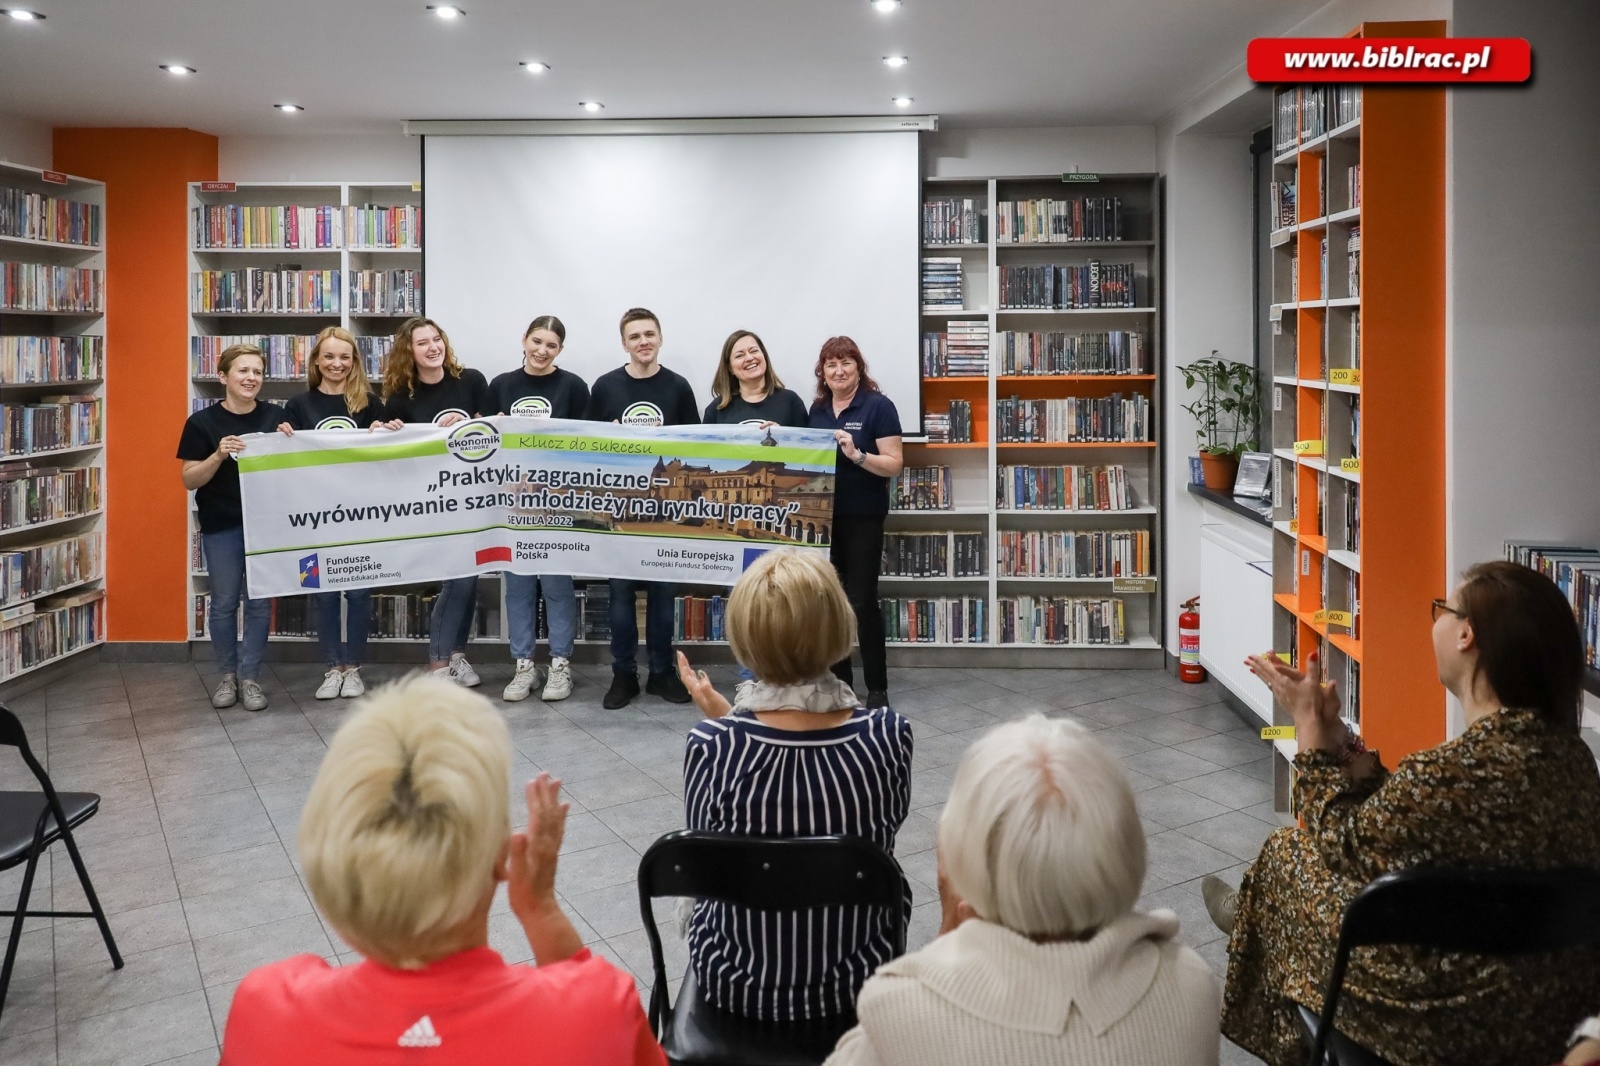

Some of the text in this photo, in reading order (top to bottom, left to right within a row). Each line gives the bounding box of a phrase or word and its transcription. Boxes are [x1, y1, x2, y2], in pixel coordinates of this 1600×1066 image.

[1090, 262, 1099, 292] LEGION
[1333, 372, 1348, 380] 200
[448, 435, 500, 448] ekonomik
[519, 436, 652, 454] Klucz do sukcesu
[1295, 442, 1310, 450] 500
[1343, 460, 1359, 468] 600
[427, 464, 520, 492] „Praktyki
[527, 468, 649, 488] zagraniczne
[288, 490, 799, 530] wyrównywanie szans młodzieży na rynku pracy”
[508, 515, 573, 526] SEVILLA 2022
[516, 541, 590, 552] Rzeczpospolita
[326, 555, 370, 566] Fundusze
[516, 551, 548, 560] Polska
[656, 548, 734, 562] Unia Europejska
[327, 562, 382, 575] Europejskie
[640, 560, 734, 572] Europejski Fundusz Społeczny
[351, 573, 378, 582] Edukacja
[380, 570, 402, 578] Rozwój
[1328, 614, 1343, 622] 800
